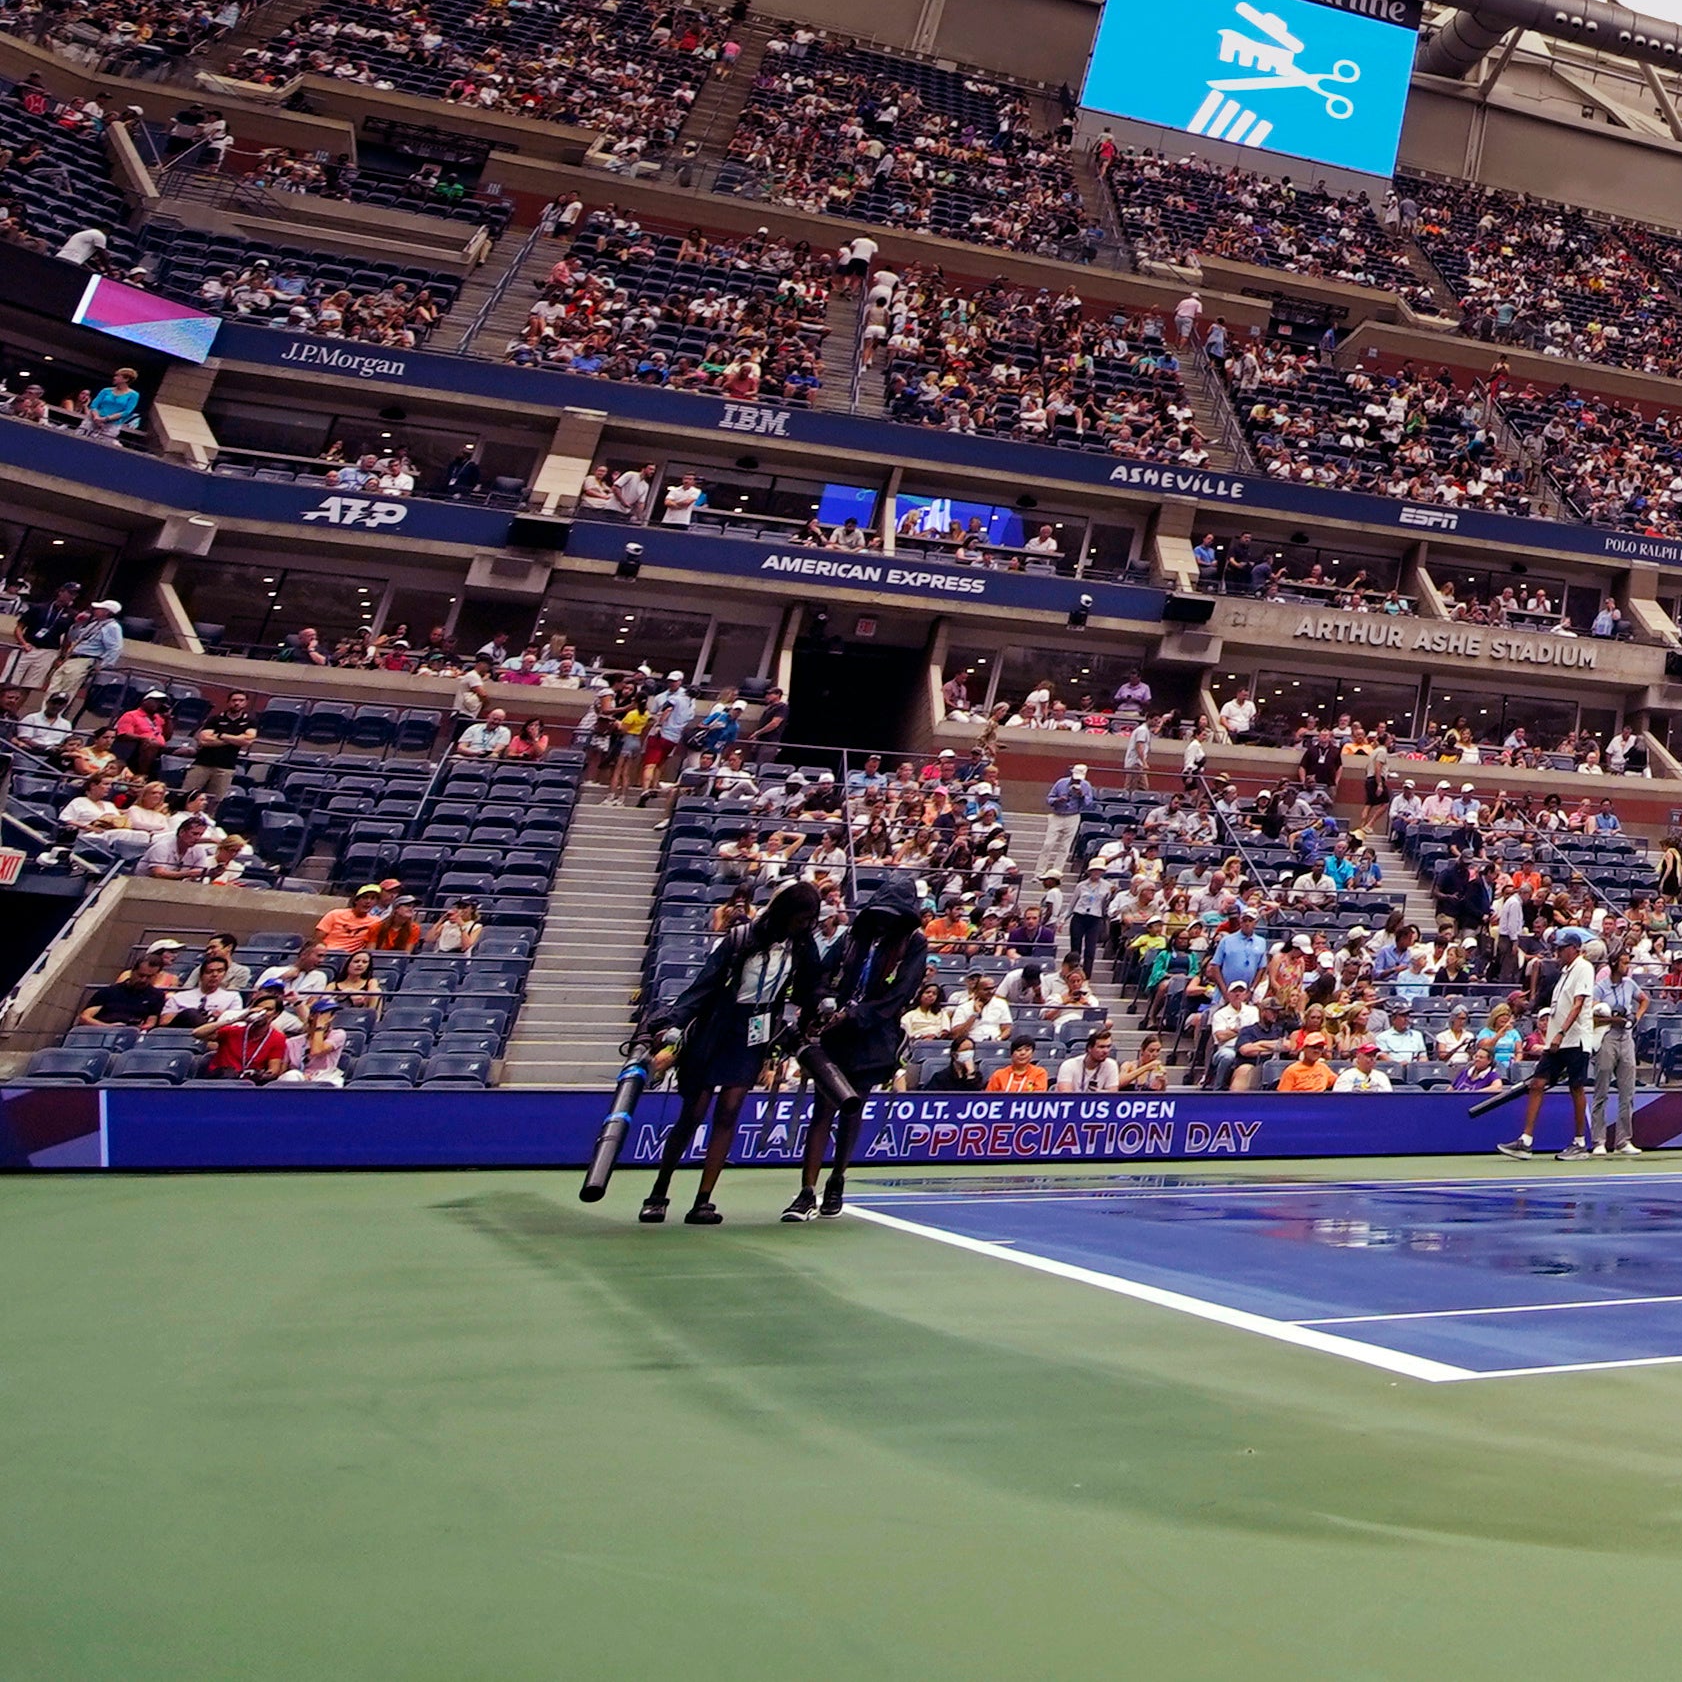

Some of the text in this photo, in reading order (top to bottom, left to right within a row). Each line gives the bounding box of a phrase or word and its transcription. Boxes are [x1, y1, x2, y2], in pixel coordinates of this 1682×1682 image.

[281, 341, 405, 379] J.P.Morgan
[718, 403, 790, 437] IBM
[302, 494, 408, 528] ATP
[1399, 506, 1459, 531] ESPN
[1604, 537, 1637, 553] POLO
[1640, 541, 1678, 559] RALPH
[761, 554, 986, 596] AMERICAN EXPRESS
[1294, 614, 1599, 670] ARTHUR ASHE STADIUM
[883, 1101, 914, 1120] TO
[920, 1101, 951, 1120] LT.
[956, 1101, 1000, 1120] JOE
[1008, 1101, 1076, 1120] HUNT
[1080, 1100, 1110, 1120] US
[1115, 1100, 1176, 1119] OPEN
[865, 1121, 1176, 1158] APPRECIATION
[1183, 1120, 1263, 1154] DAY
